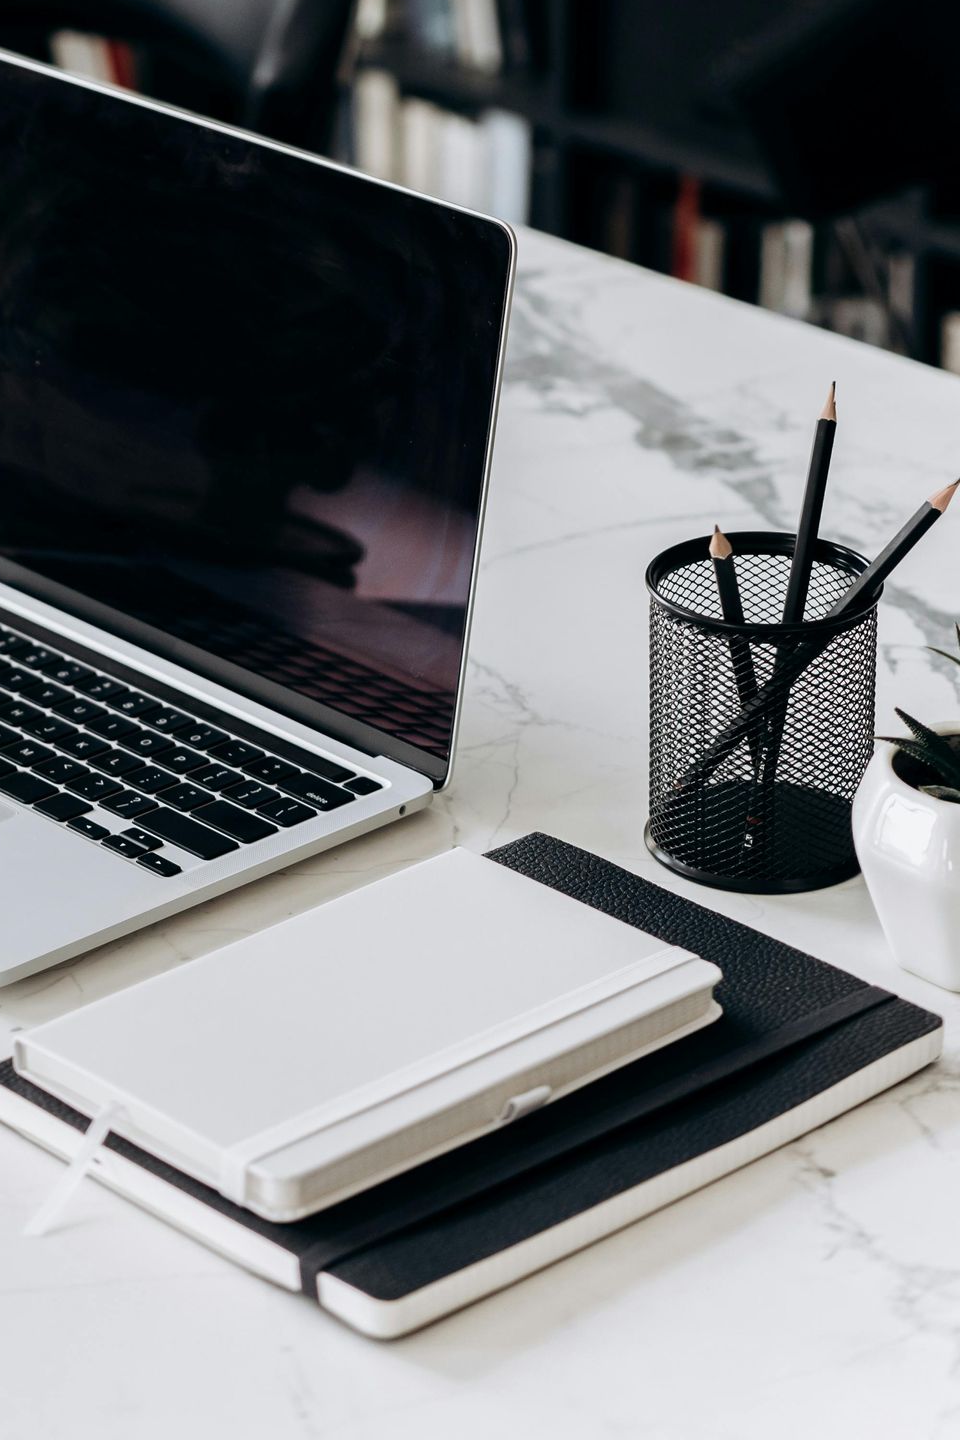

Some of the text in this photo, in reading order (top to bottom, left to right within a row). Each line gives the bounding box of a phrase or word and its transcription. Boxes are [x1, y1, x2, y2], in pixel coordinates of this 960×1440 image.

[73, 706, 86, 714] U
[190, 734, 202, 742] 0
[76, 741, 89, 749] K
[20, 748, 34, 756] M
[110, 758, 120, 766] L
[306, 792, 328, 804] delete
